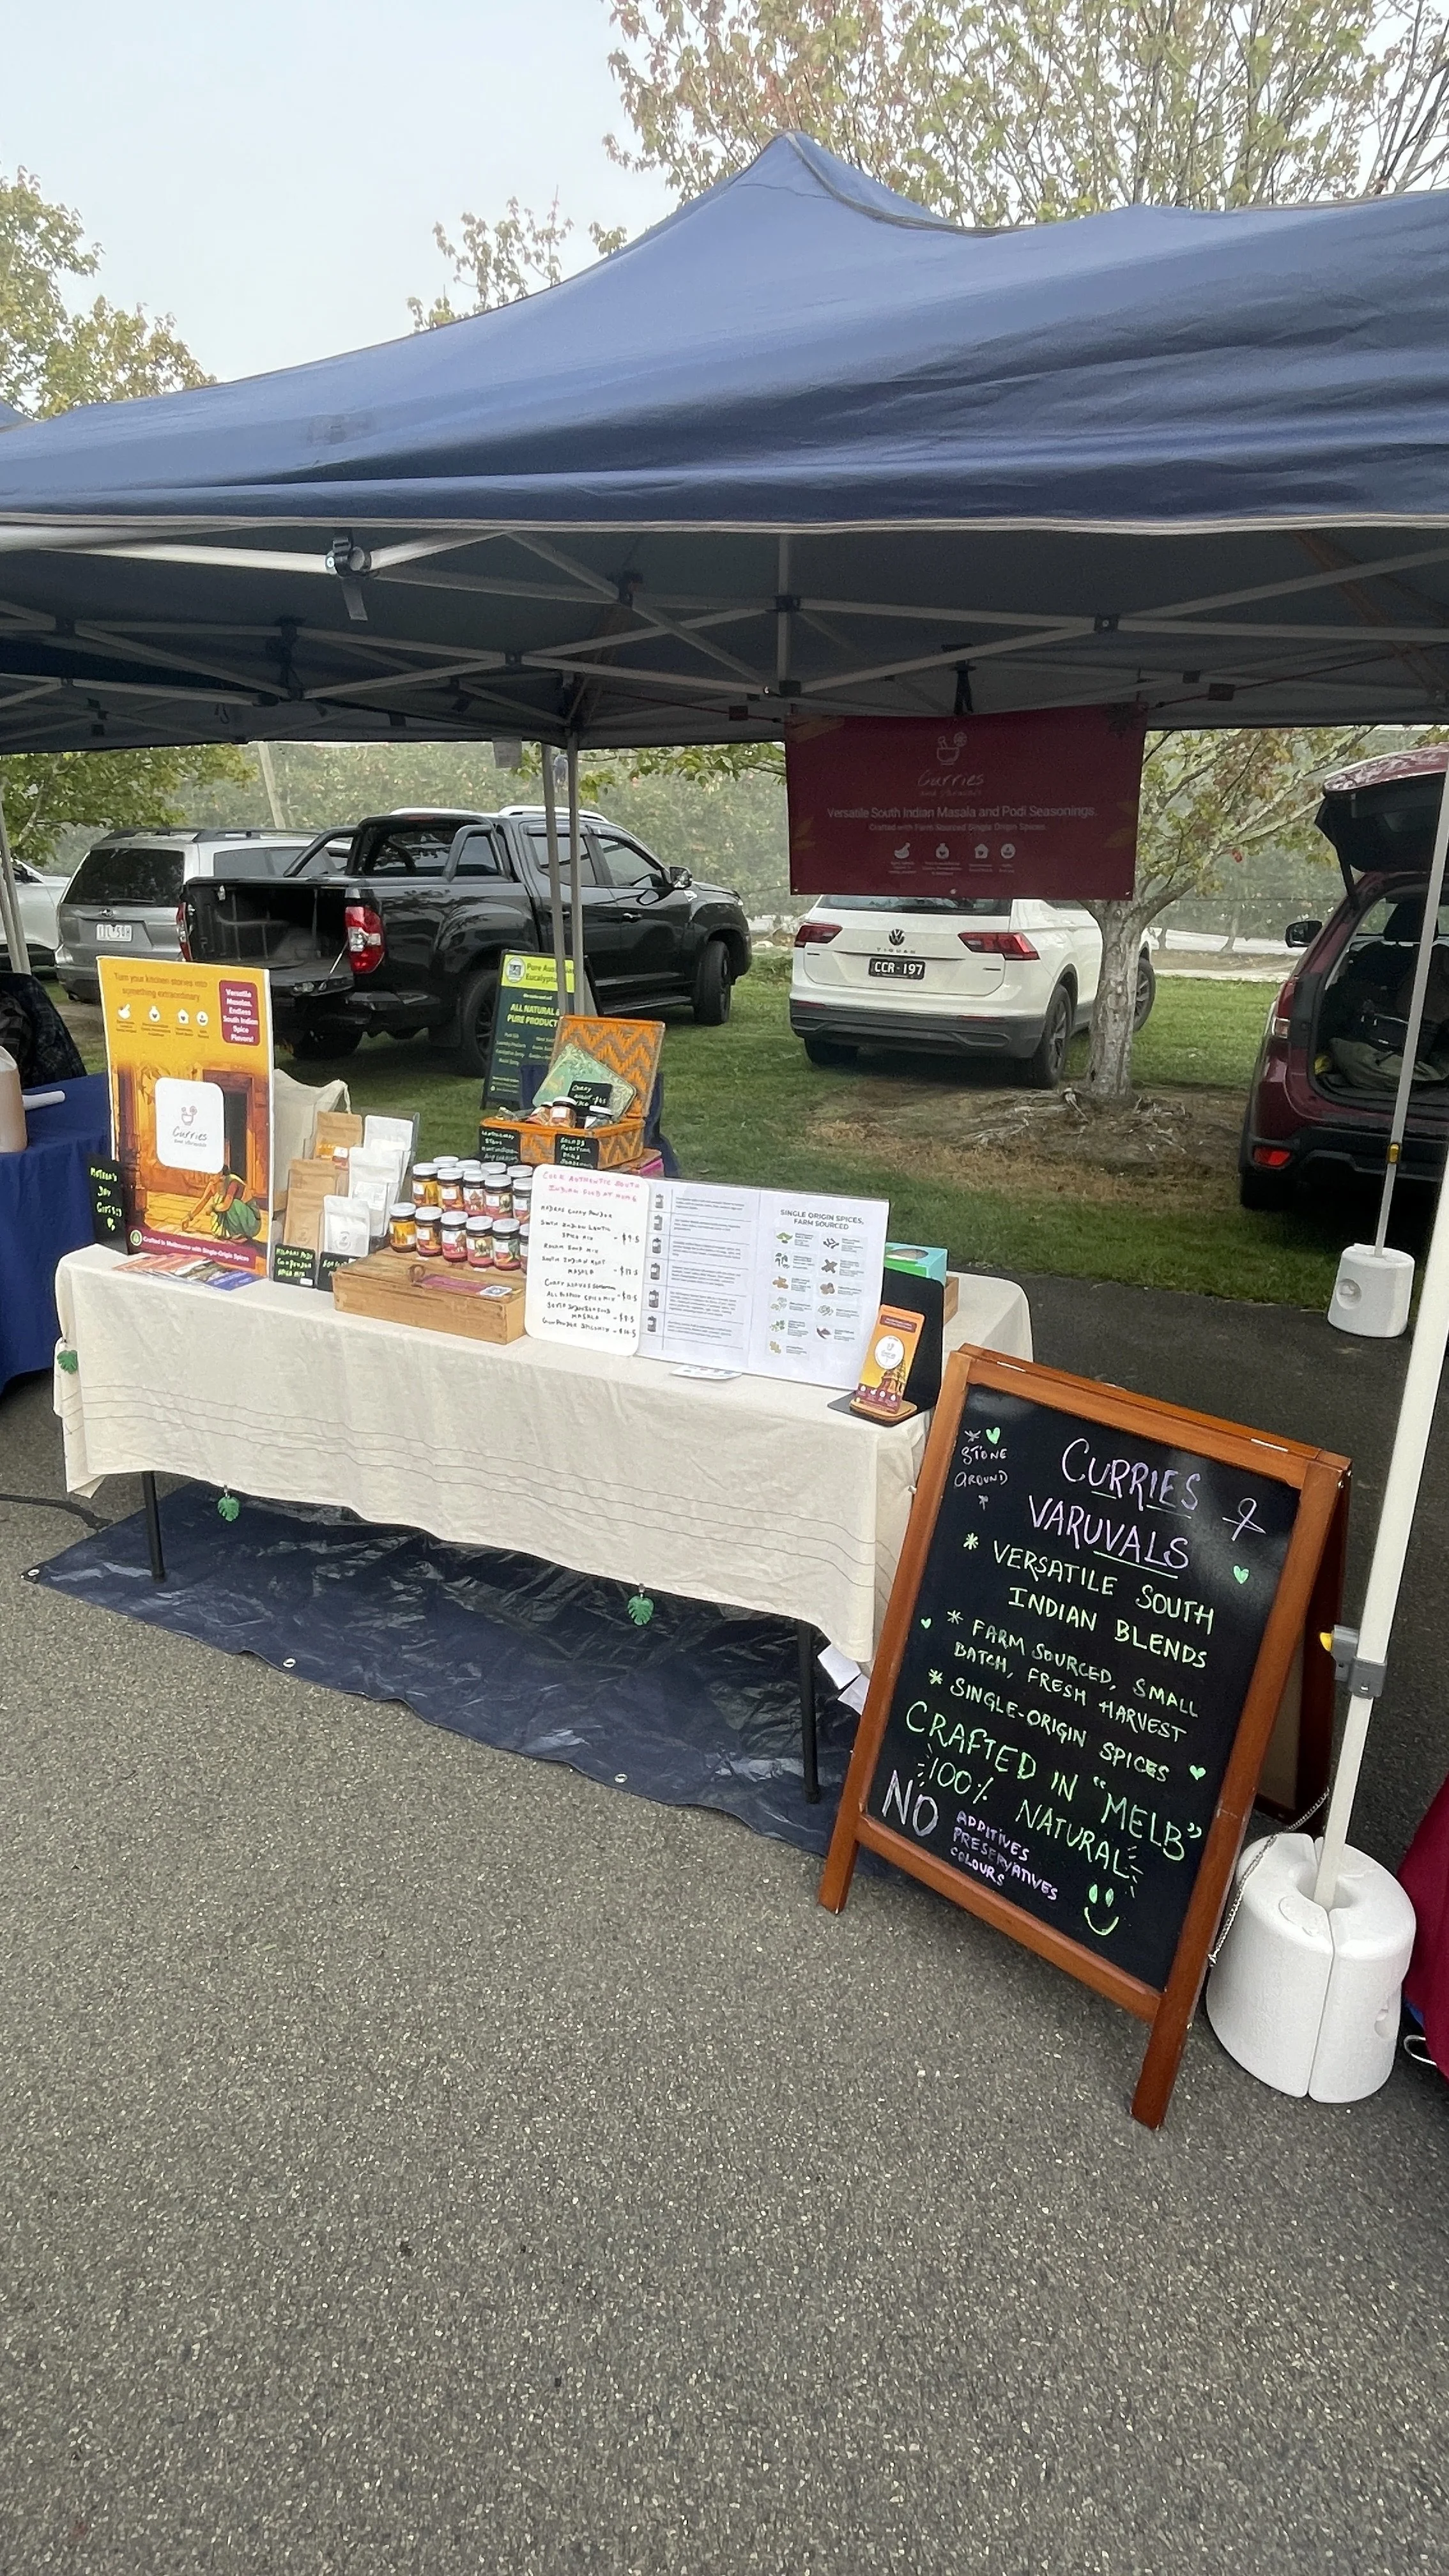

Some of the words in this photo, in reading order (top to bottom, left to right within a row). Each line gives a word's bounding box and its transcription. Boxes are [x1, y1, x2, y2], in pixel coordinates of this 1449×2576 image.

[827, 808, 870, 818] Versatile
[871, 807, 901, 818] South
[903, 807, 934, 818] Indian
[937, 806, 976, 818] Masala
[979, 806, 999, 818] and
[1002, 805, 1027, 818] Podi
[917, 769, 985, 787] Curries
[114, 972, 129, 981] Turn
[130, 975, 144, 983] your
[510, 1003, 523, 1012] ALL
[524, 1005, 555, 1016] NATURAL
[507, 1014, 525, 1023] PURE
[172, 1126, 208, 1141] Curries
[780, 1209, 806, 1218] SINGLE
[808, 1212, 834, 1221] ORIGIN
[836, 1215, 864, 1225] SPICES,
[815, 1221, 849, 1230] SOURCED
[962, 1445, 1008, 1465] STONE
[1062, 1438, 1201, 1512] CURRIES
[1029, 1495, 1189, 1570] VARUVALS
[993, 1540, 1118, 1596] VERSATILE
[1135, 1584, 1214, 1635] SOUTH
[1008, 1586, 1098, 1631] INDIAN
[1114, 1619, 1208, 1669] BLENDS
[954, 1641, 1015, 1680] BATCH,
[1028, 1667, 1087, 1706] FRESH
[1098, 1701, 1188, 1743] HARVEST
[972, 1619, 1025, 1656] FARM
[1031, 1643, 1117, 1690] SOURCED,
[1132, 1678, 1199, 1719] SMALL
[905, 1700, 1037, 1780] CRAFTED
[1051, 1771, 1078, 1802] IN
[950, 1677, 1087, 1749] SINGLE-ORIGIN
[1099, 1742, 1170, 1783] SPICES
[882, 1769, 939, 1837] NO
[956, 1810, 1030, 1862] ADDITIVES
[928, 1757, 994, 1805] 100%
[1015, 1798, 1130, 1880] NATURAL
[951, 1846, 1005, 1887] COLOURS
[953, 1828, 1058, 1901] PRESERVATIVES
